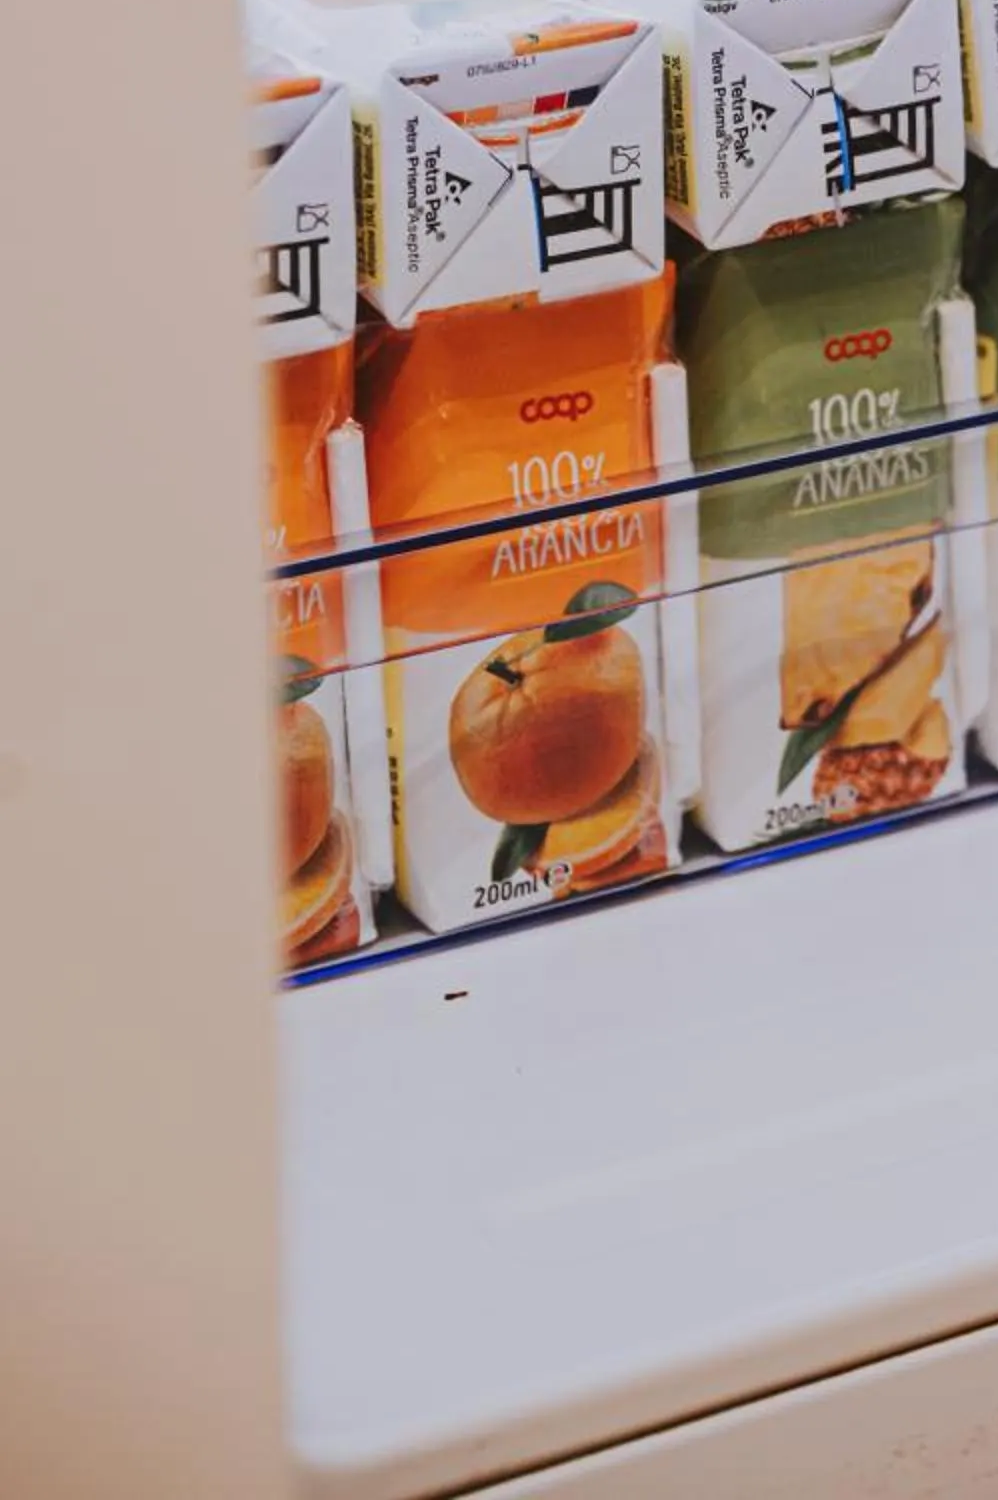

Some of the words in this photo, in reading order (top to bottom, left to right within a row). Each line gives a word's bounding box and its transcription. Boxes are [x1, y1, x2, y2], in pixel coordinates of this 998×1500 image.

[711, 48, 724, 85] Tetra
[731, 76, 748, 124] Tetra
[405, 116, 419, 154] Tetra
[424, 145, 441, 195] Tetra
[407, 212, 420, 273] Aseptic
[824, 329, 892, 362] coop
[519, 391, 594, 423] coop
[808, 388, 901, 446] 100%
[508, 450, 606, 509] 100%
[793, 448, 930, 509] ANANAS
[492, 511, 645, 578] ARANCIA
[474, 876, 538, 908] 200ml
